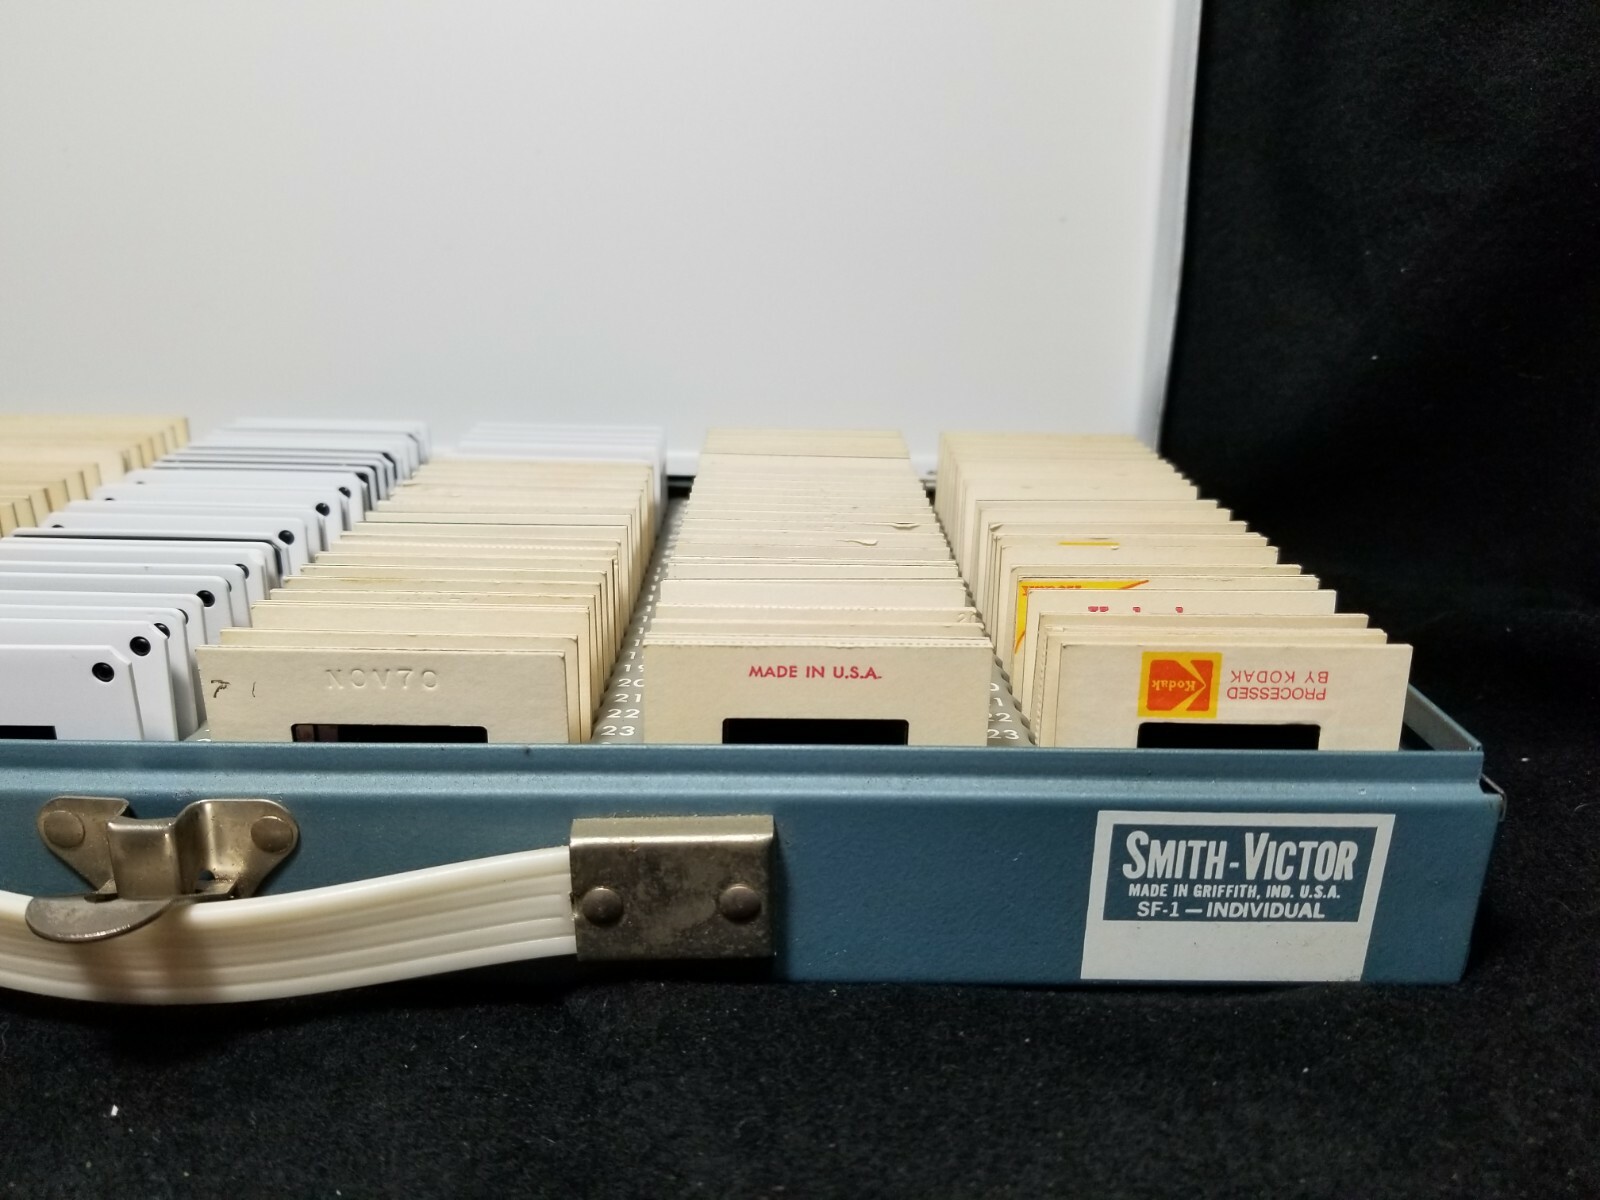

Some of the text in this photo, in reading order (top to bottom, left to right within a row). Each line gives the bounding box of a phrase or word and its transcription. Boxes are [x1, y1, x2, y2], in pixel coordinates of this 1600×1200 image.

[749, 665, 882, 679] MADE IN U.S.A.
[1230, 670, 1329, 684] BY KODAK
[1151, 679, 1197, 692] Kodak
[614, 693, 642, 703] 21
[1226, 686, 1327, 700] PROCESSED
[607, 708, 640, 719] 22
[601, 725, 635, 736] 23
[1122, 830, 1358, 880] SMITH-VICTOR
[1128, 883, 1341, 899] MADE IN GRIFFITH, IND. U.S.A.
[1137, 901, 1180, 917] SF-1
[1206, 902, 1325, 919] INDIVIDUAL
